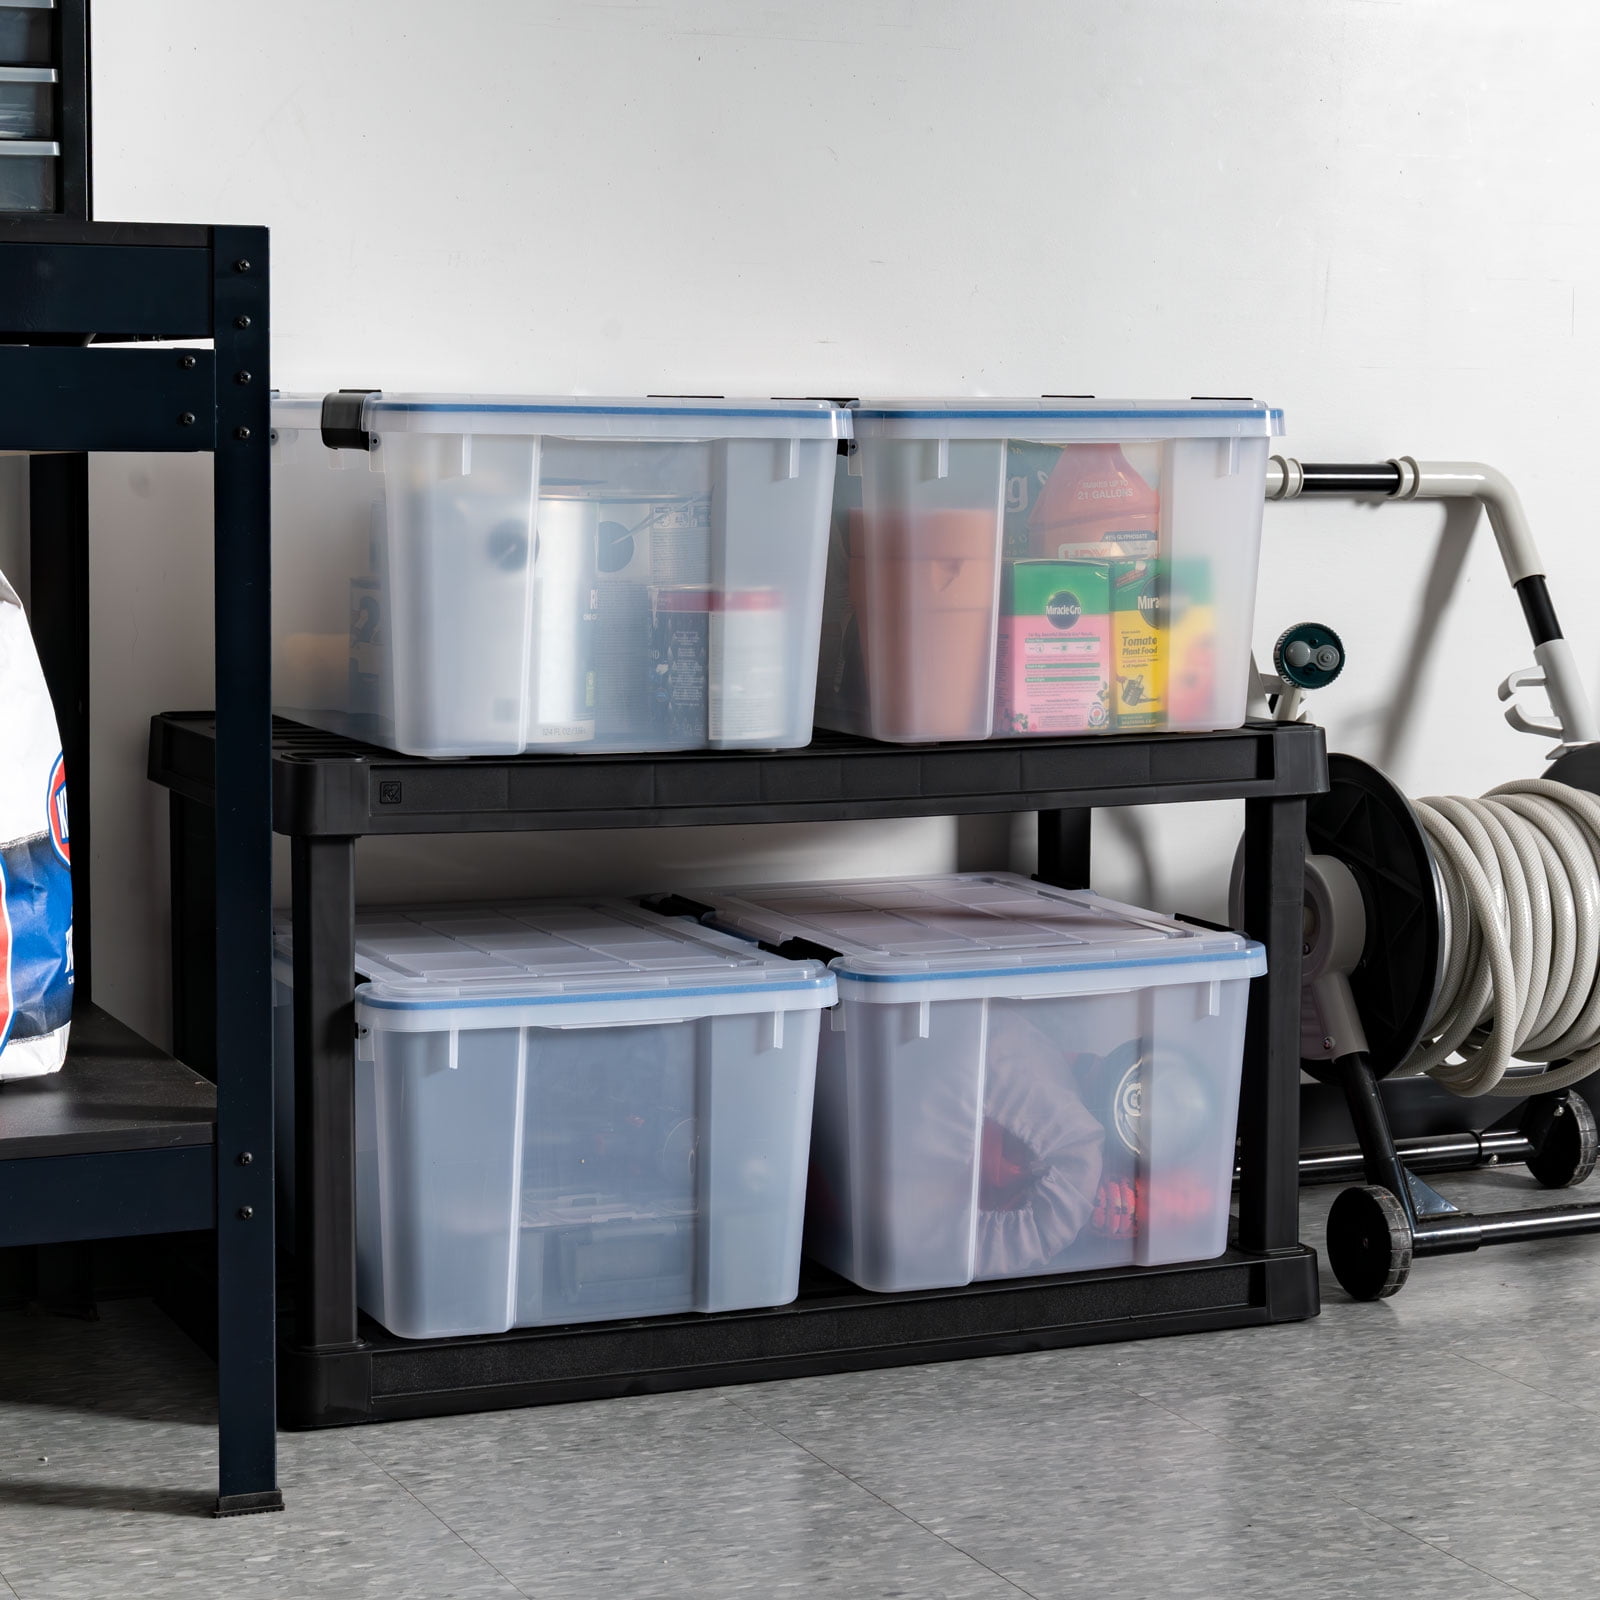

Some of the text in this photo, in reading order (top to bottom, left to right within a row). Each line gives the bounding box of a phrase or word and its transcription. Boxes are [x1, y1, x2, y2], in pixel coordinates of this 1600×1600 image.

[1120, 479, 1128, 487] TO
[1077, 488, 1134, 500] 21 GALLONS
[1122, 645, 1158, 656] Plant Food
